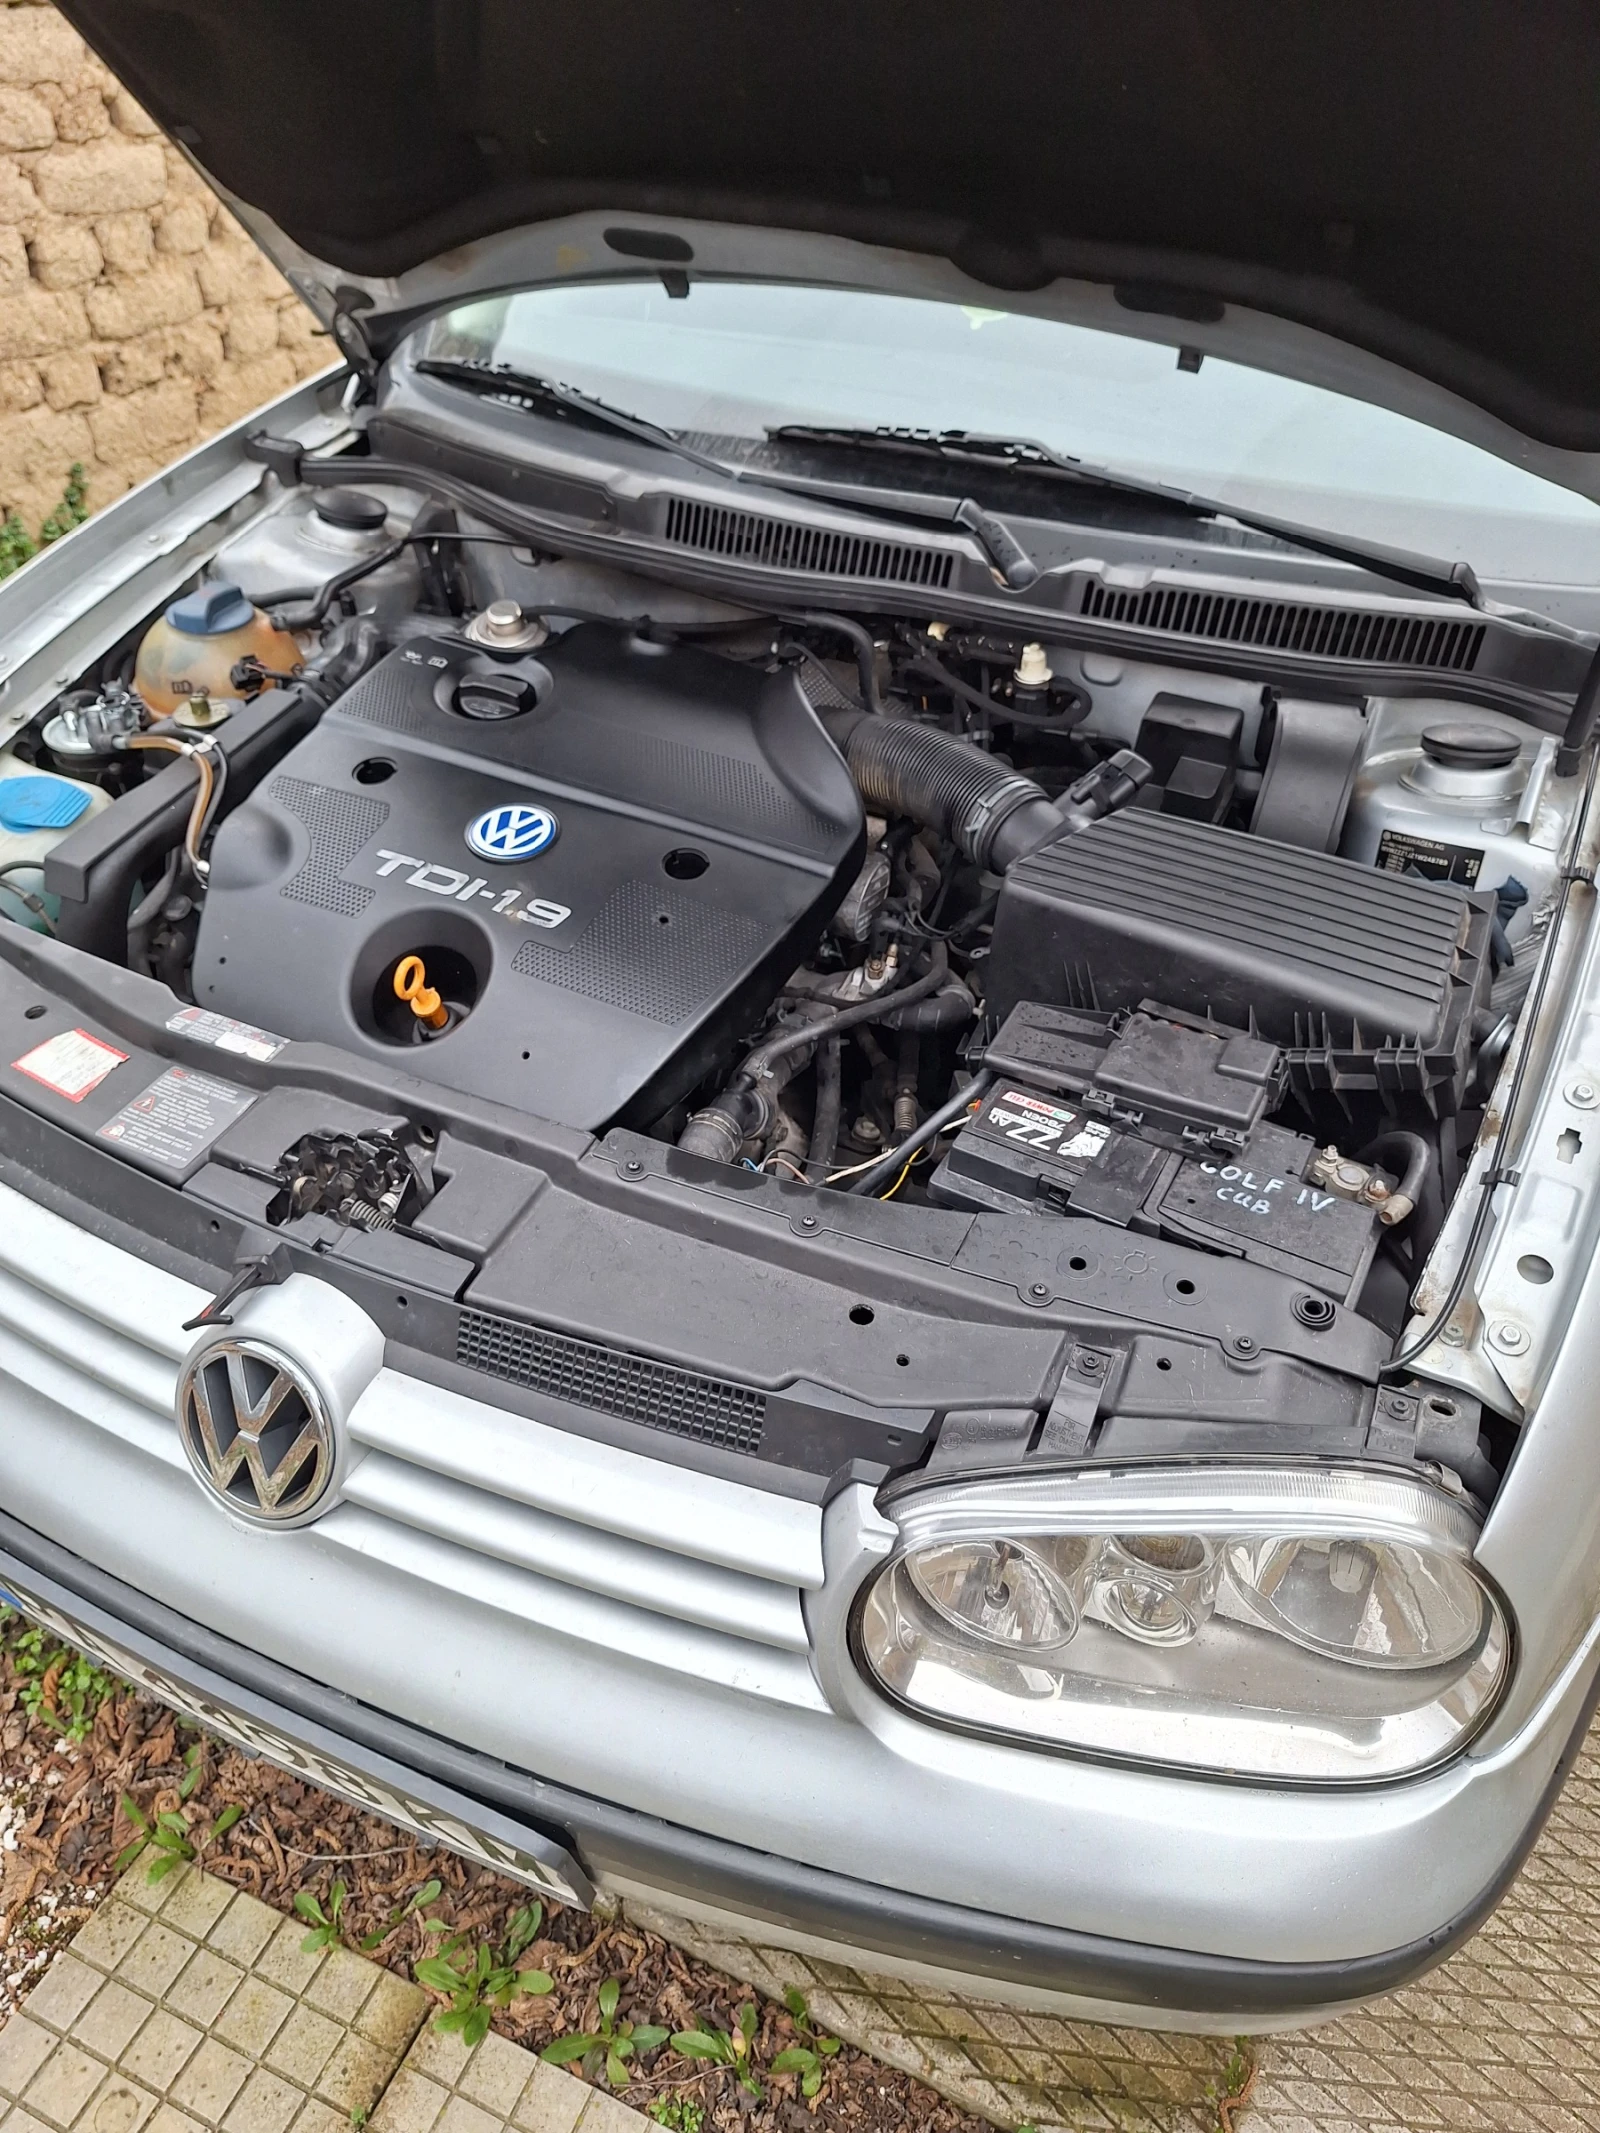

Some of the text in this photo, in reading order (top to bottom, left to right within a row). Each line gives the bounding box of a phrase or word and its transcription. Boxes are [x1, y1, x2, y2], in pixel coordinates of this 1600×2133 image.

[470, 805, 555, 857] VW
[1391, 833, 1434, 849] VOLKSWAGEN
[1008, 1094, 1055, 1114] POWER CELL
[1021, 1110, 1066, 1131] 780EN
[988, 1113, 1059, 1151] 77 Ah
[1296, 1188, 1336, 1211] IV
[178, 1338, 333, 1524] VW
[1044, 1429, 1057, 1441] SEE
[1063, 1418, 1076, 1431] FOR
